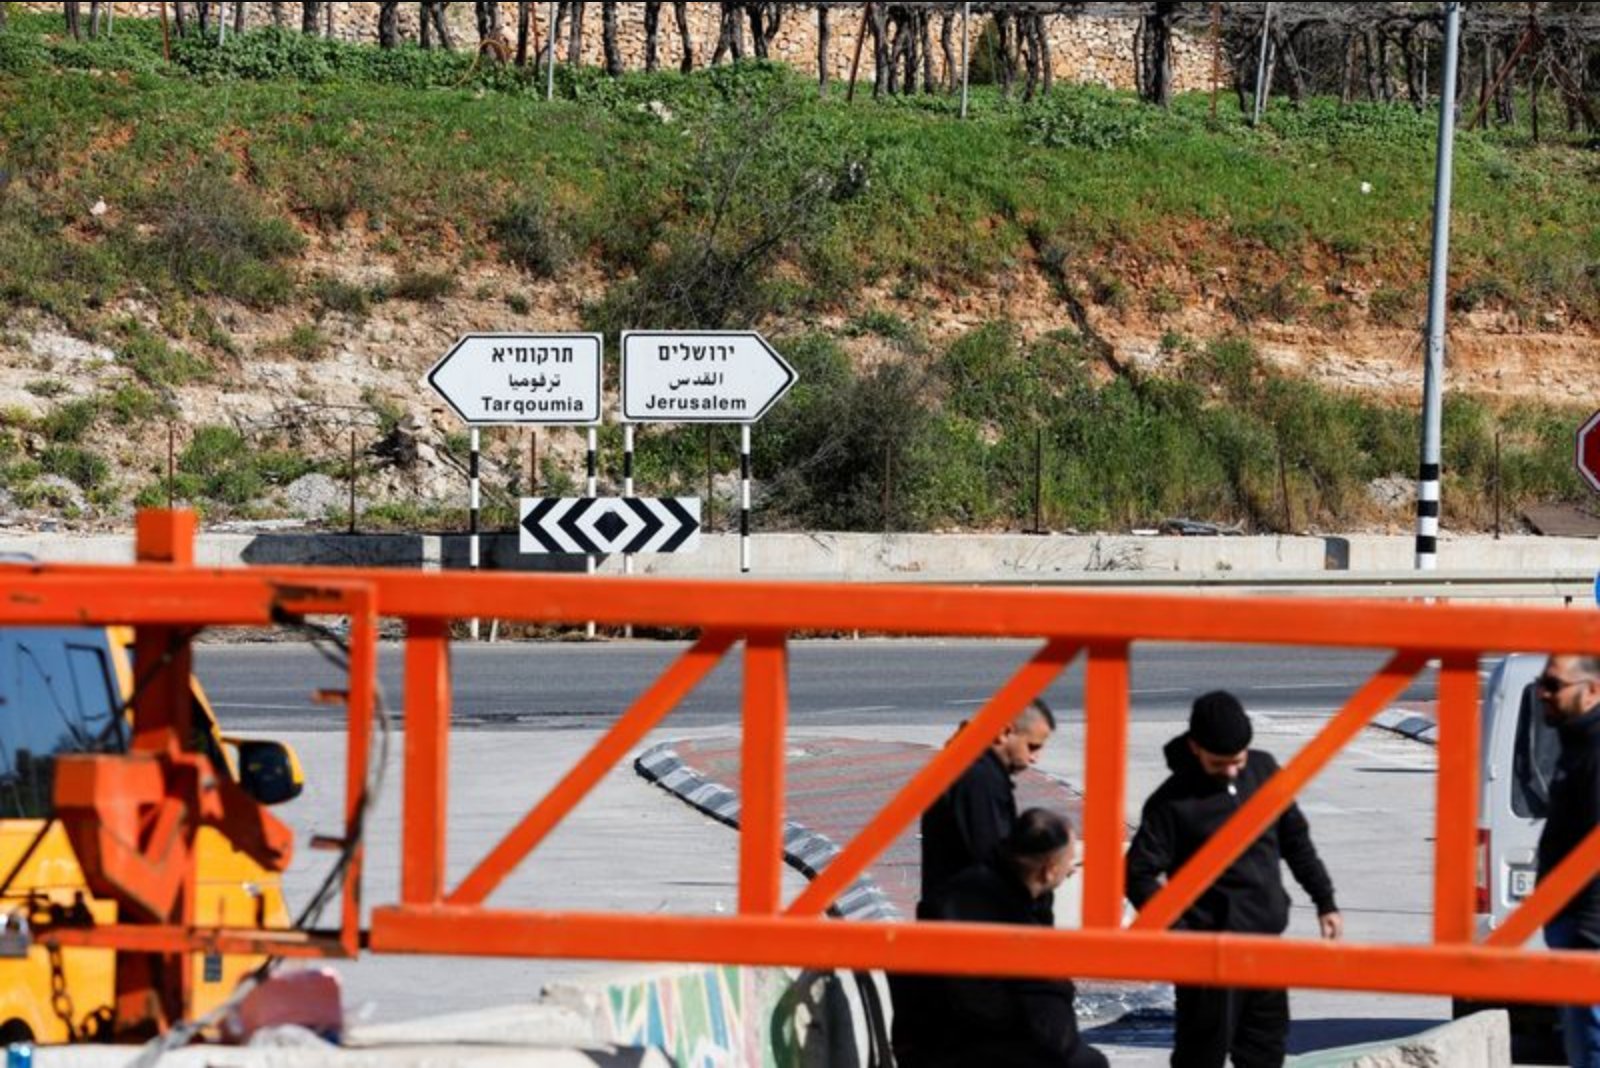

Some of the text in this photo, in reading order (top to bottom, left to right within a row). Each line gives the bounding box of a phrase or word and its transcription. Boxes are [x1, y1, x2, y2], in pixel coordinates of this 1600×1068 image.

[491, 346, 573, 365] תרקומיא
[657, 343, 734, 361] ירושלים
[668, 371, 723, 390] القدس
[481, 396, 584, 414] Tarqoumia
[645, 394, 747, 410] Jerusalem
